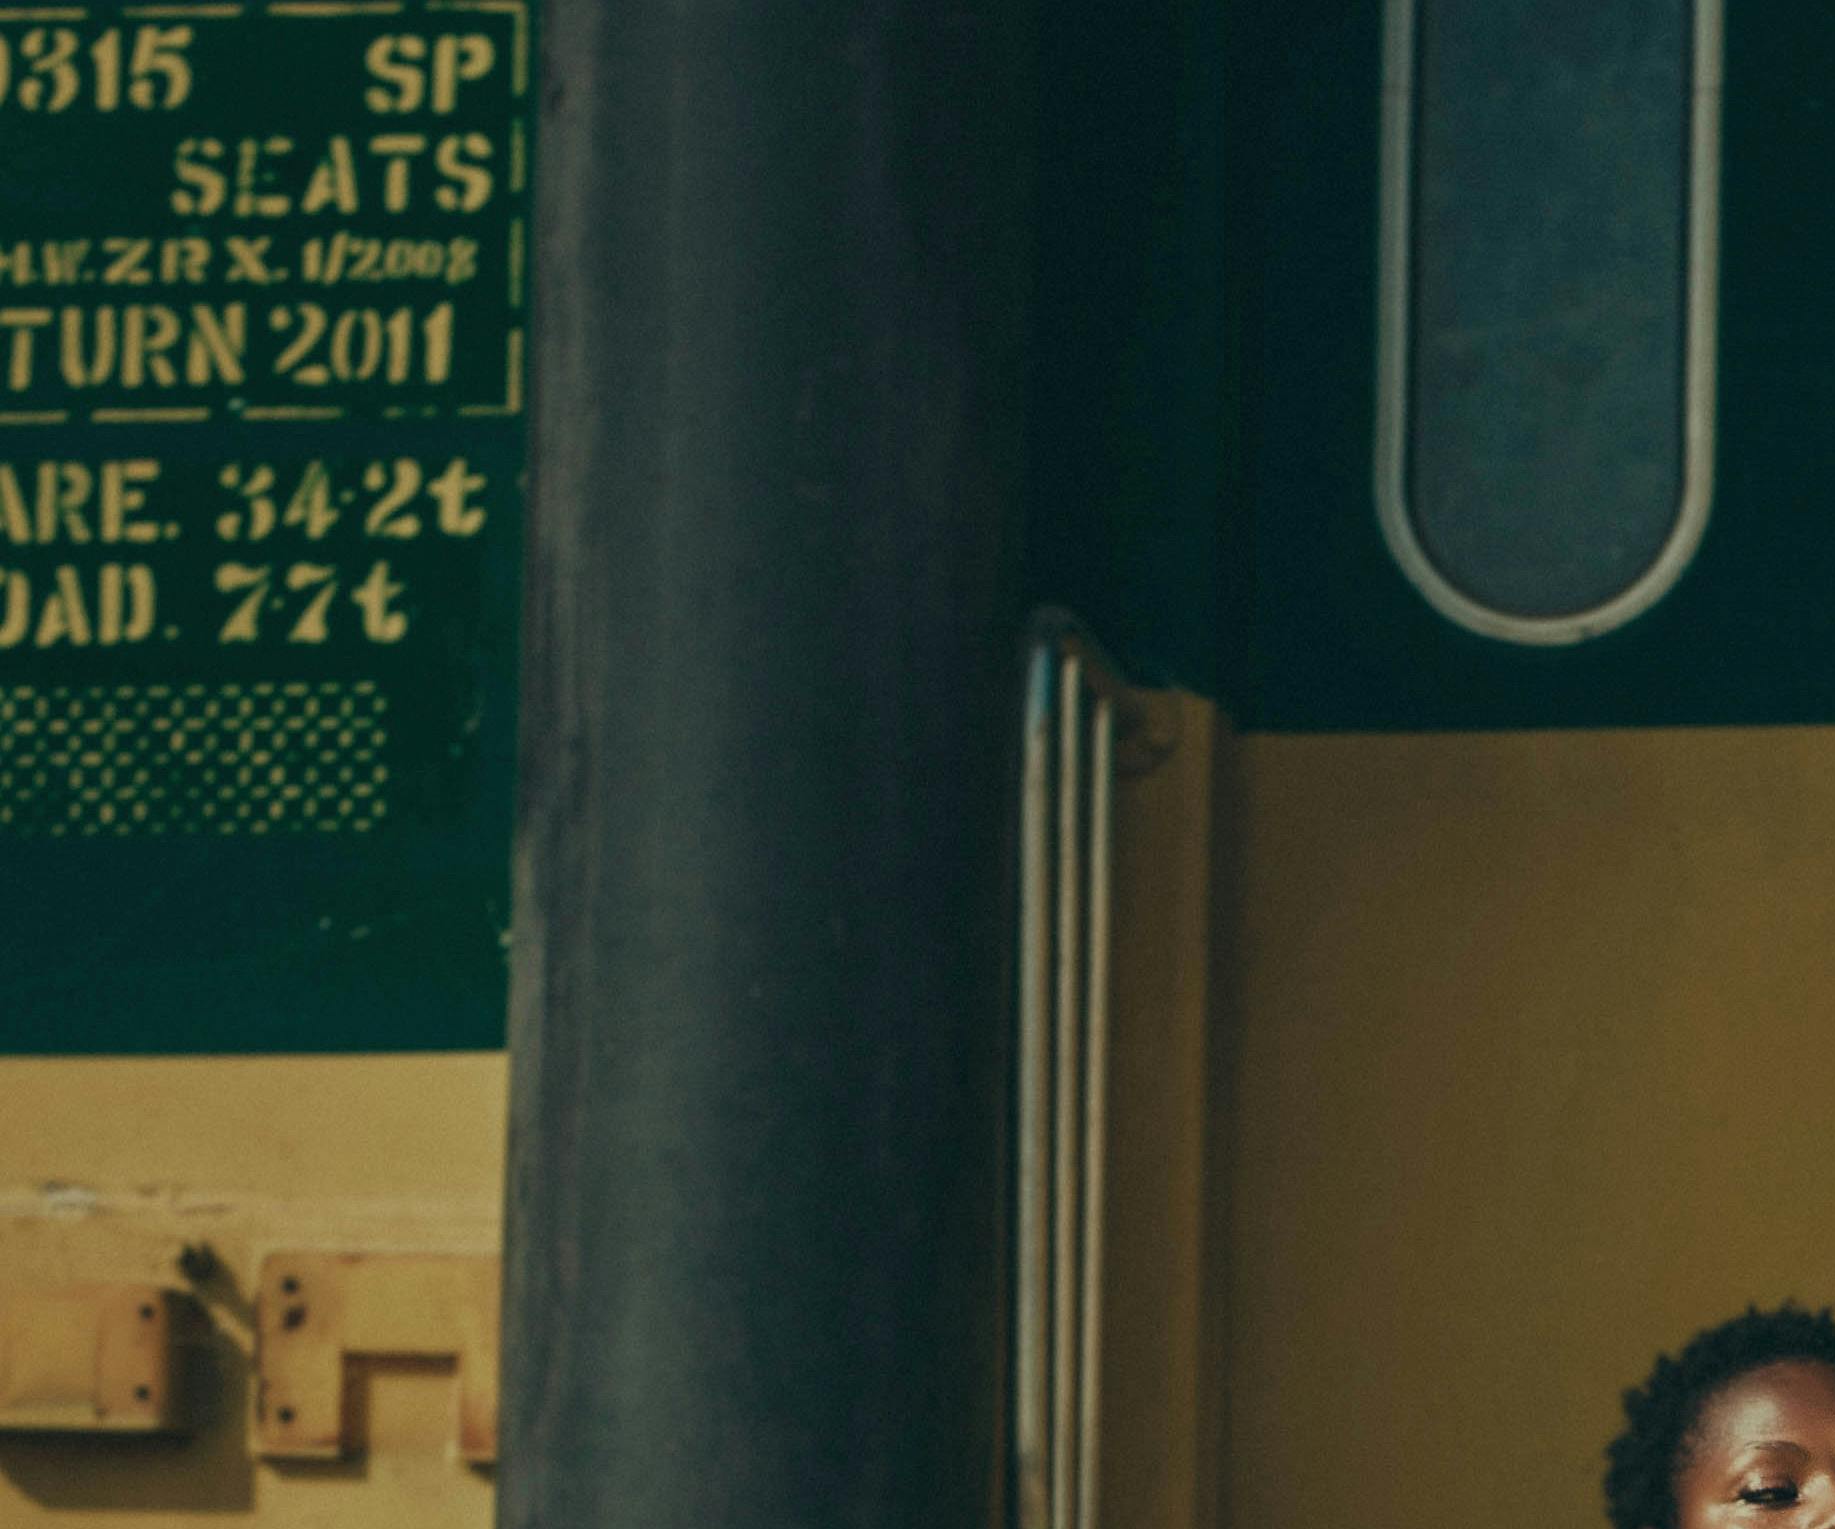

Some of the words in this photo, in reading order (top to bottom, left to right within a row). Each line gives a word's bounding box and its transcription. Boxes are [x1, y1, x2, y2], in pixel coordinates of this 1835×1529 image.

[0, 25, 192, 112] 315
[366, 34, 494, 113] SP
[171, 133, 493, 215] SEATS
[0, 302, 245, 390] TURN
[270, 303, 453, 386] 2011
